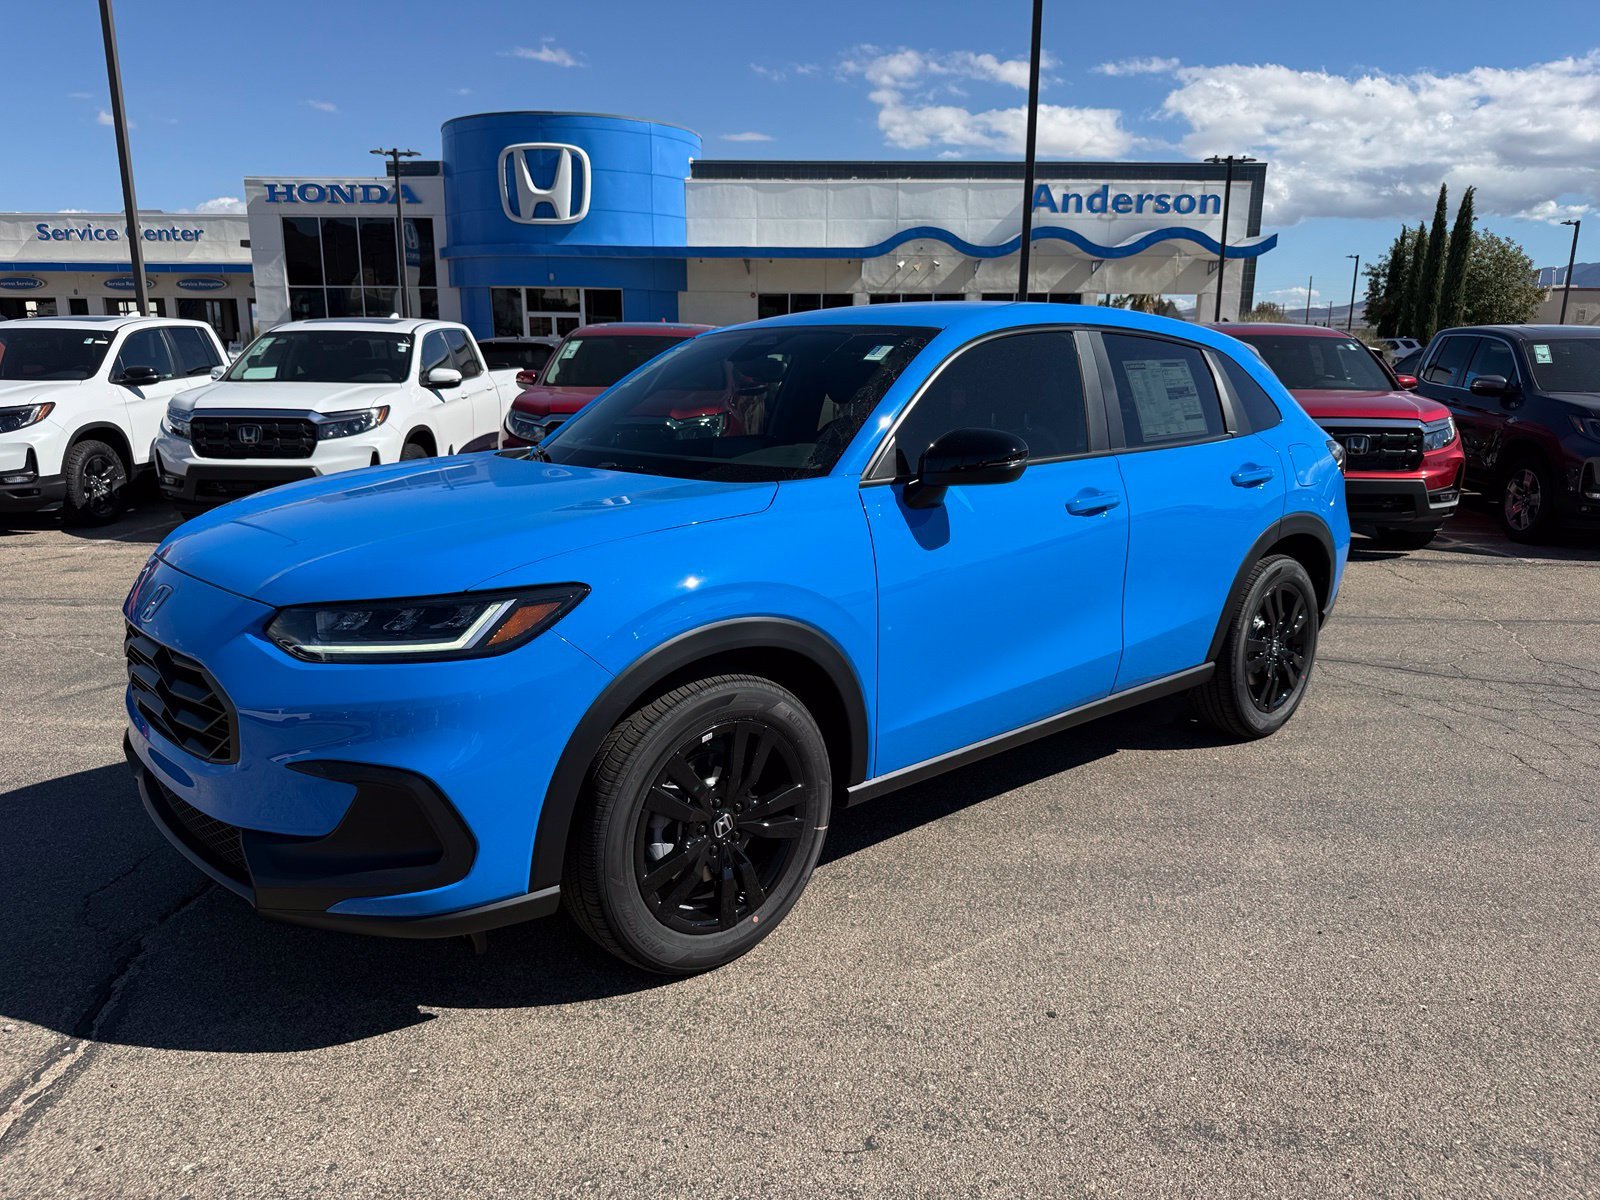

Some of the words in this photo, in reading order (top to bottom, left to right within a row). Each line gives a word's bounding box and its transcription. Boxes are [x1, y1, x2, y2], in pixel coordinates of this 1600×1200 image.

[263, 182, 422, 205] HONDA
[1032, 183, 1222, 215] Anderson
[36, 223, 120, 242] Service
